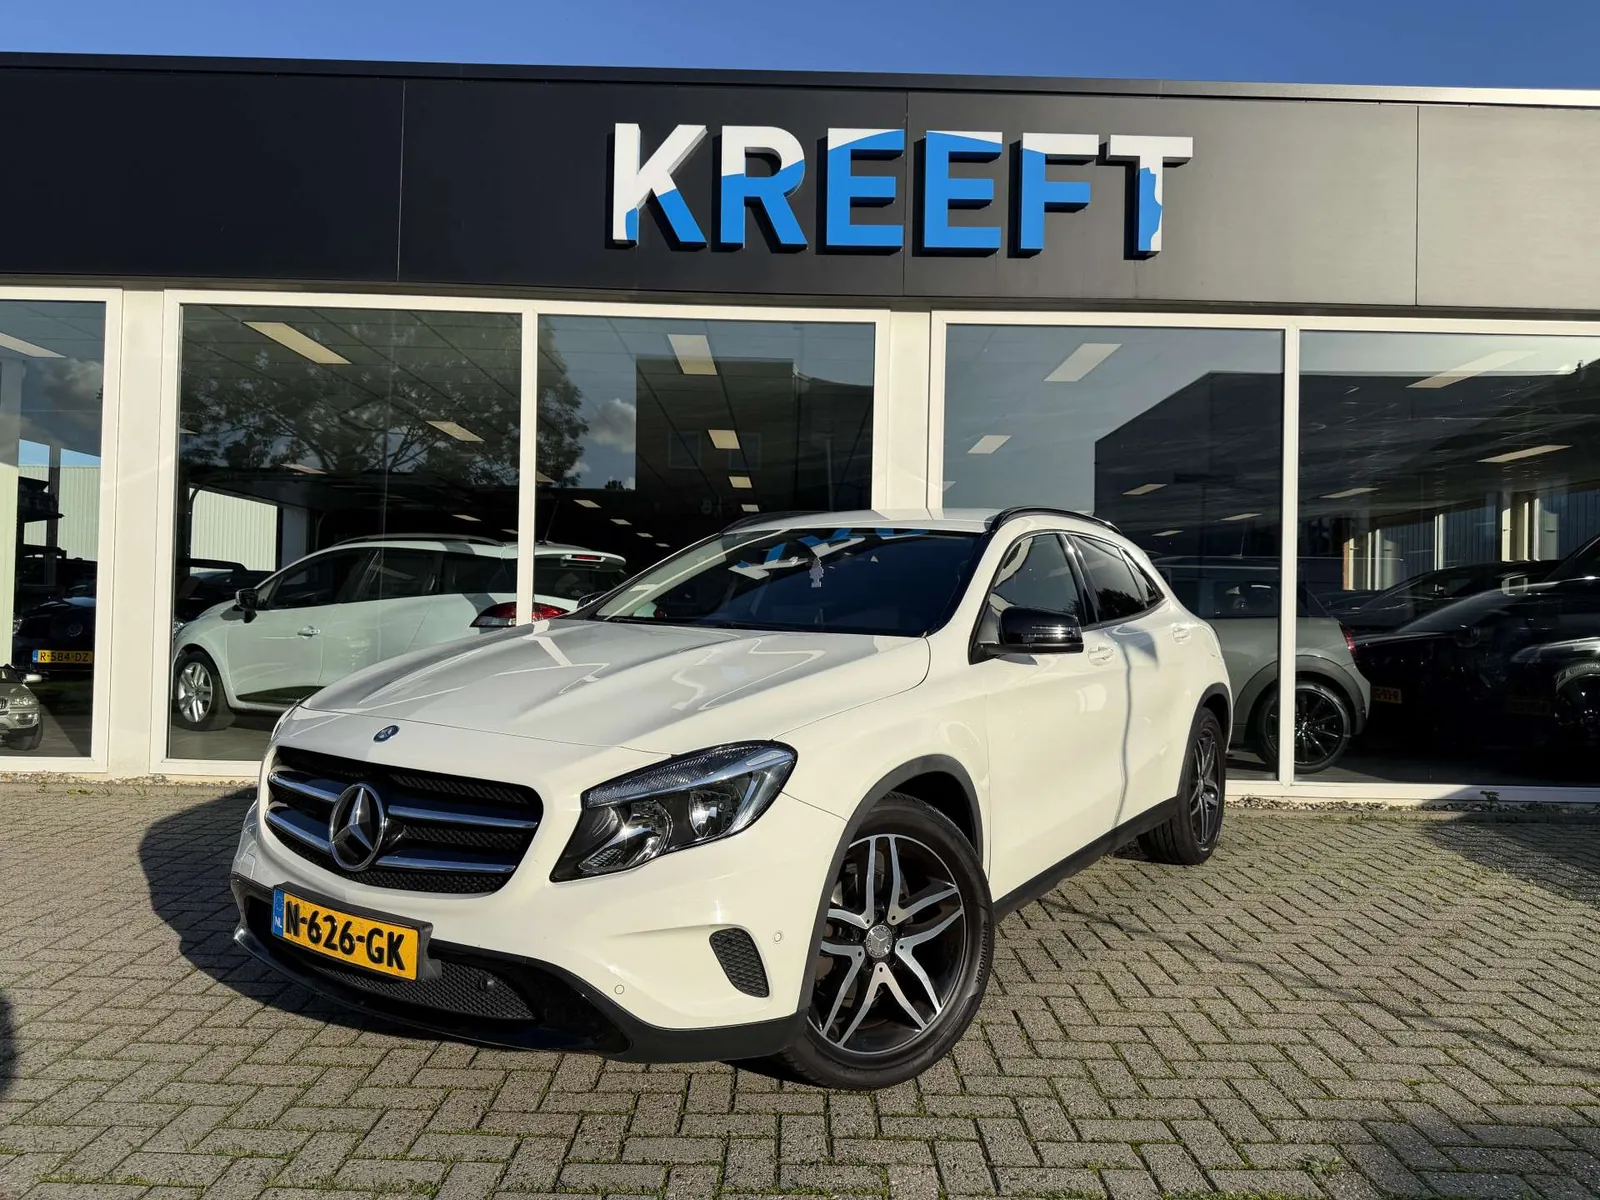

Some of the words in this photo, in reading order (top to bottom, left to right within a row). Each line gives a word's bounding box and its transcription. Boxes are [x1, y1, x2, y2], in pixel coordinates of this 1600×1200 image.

[611, 122, 1194, 253] KREEFT
[40, 651, 89, 662] R-584-DZ
[285, 900, 406, 971] N-626-GK
